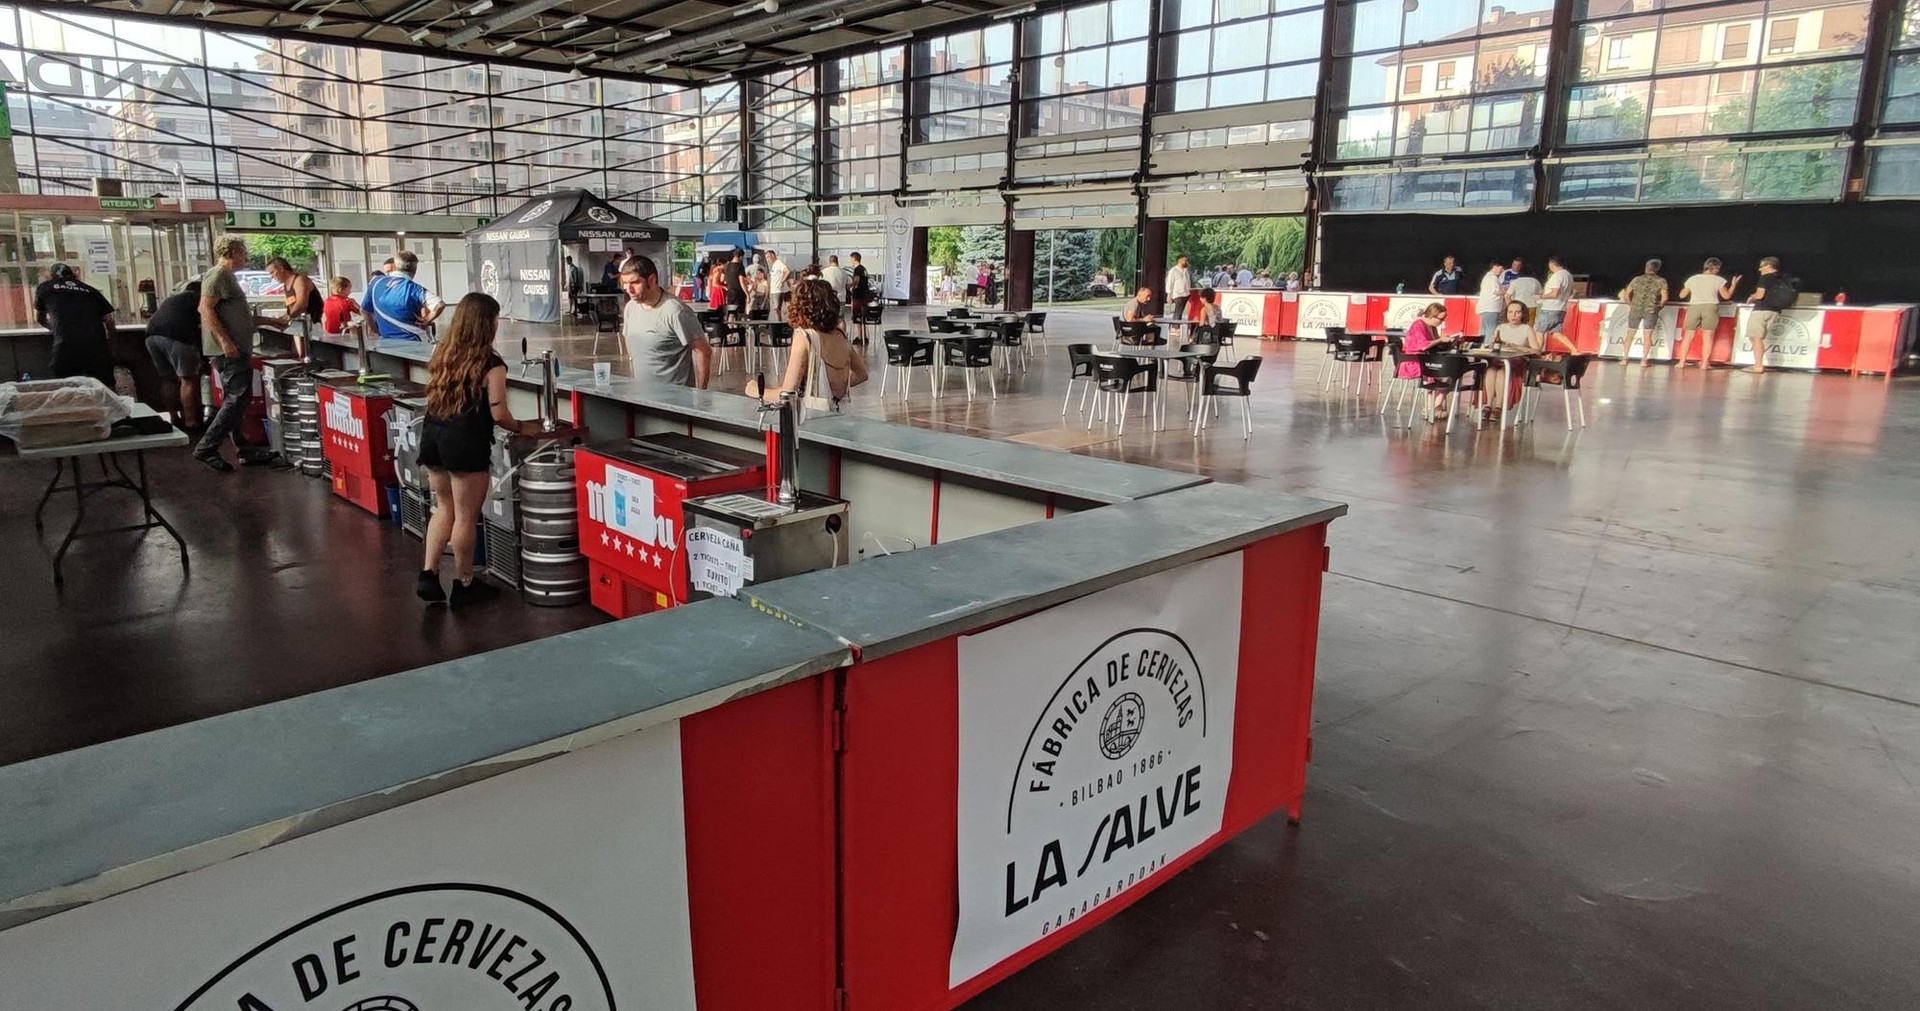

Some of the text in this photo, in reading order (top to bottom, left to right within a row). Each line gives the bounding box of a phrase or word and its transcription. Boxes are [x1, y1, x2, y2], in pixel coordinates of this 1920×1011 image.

[486, 230, 531, 241] NISSAN GAURSA
[579, 230, 652, 239] NISSAN GAURSA
[520, 269, 550, 281] NISSAN
[523, 285, 549, 296] GAURSA
[689, 532, 740, 552] CERVEZA CAÑA
[1029, 649, 1194, 792] FÁBRICA DE CERVEZAS
[1071, 753, 1164, 807] BILBAO 1886
[1005, 764, 1202, 918] LA SALVE
[291, 934, 361, 1003] DE
